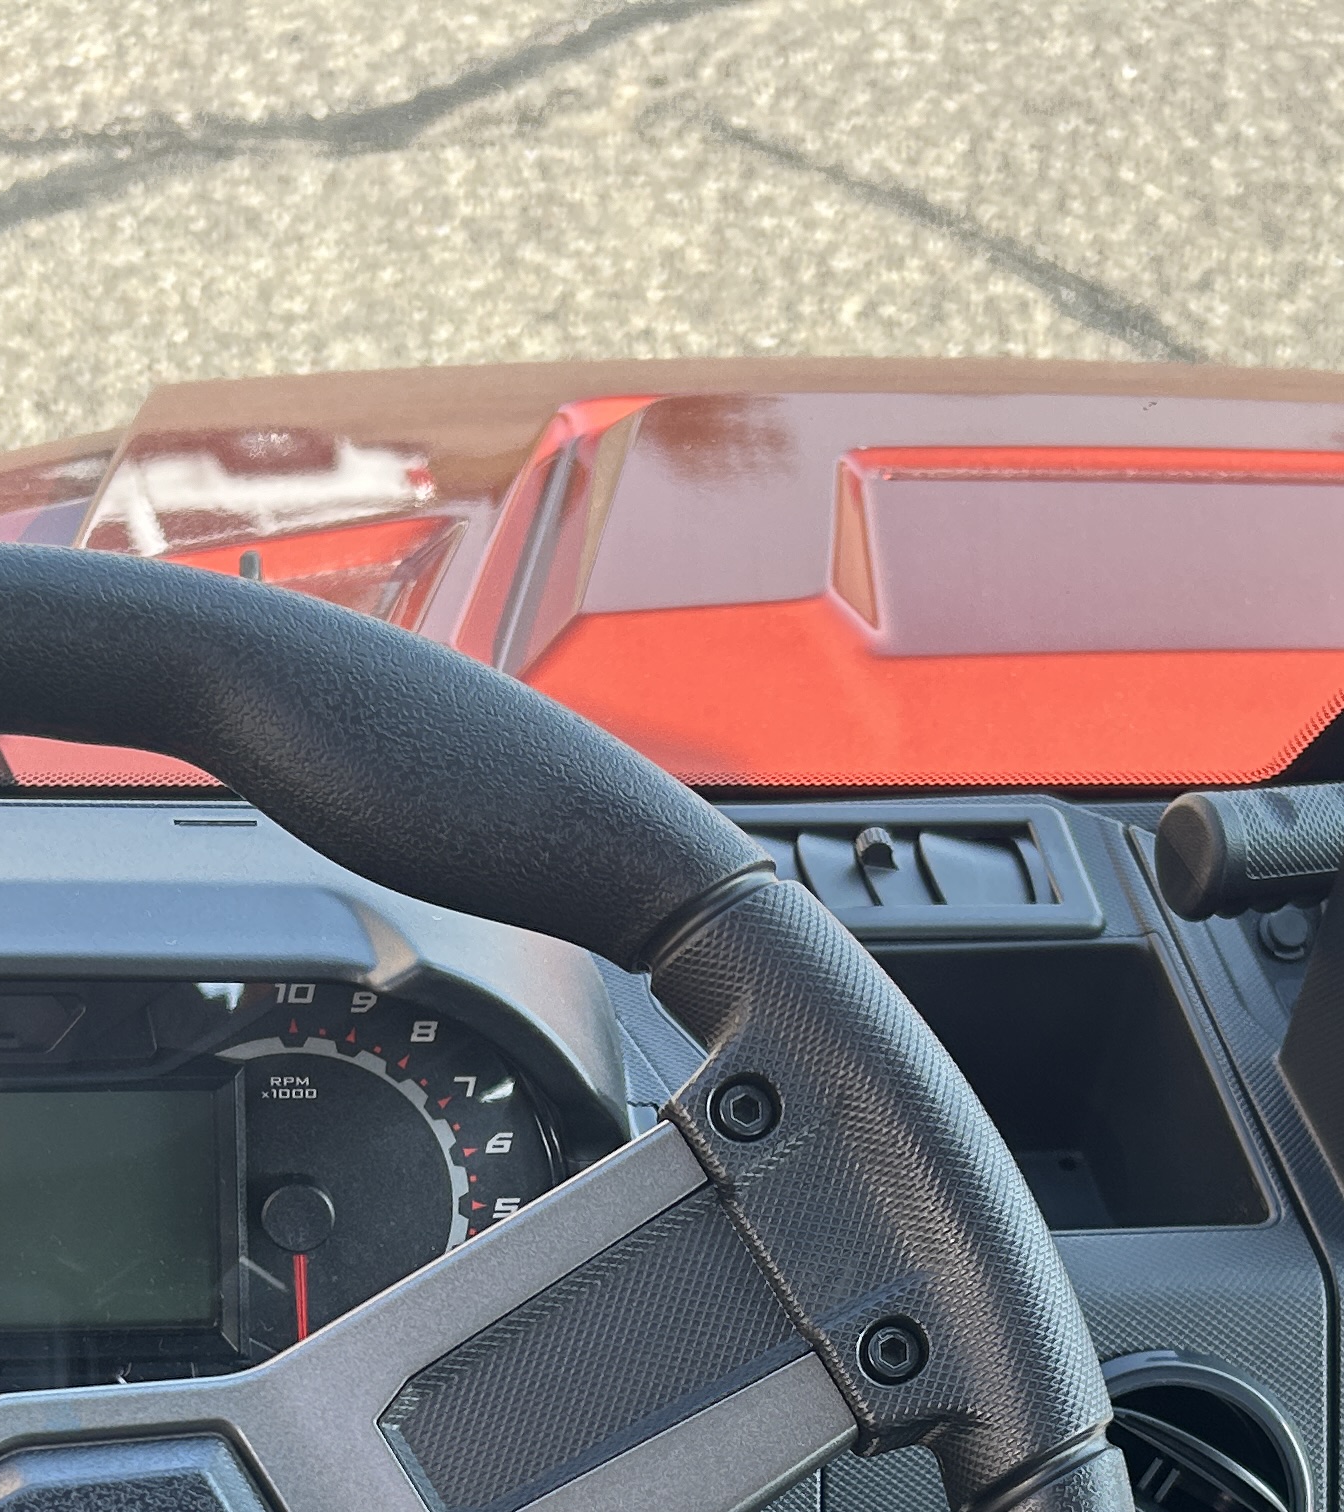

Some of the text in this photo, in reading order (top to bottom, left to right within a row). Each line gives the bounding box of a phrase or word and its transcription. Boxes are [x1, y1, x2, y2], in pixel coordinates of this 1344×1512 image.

[274, 983, 316, 1004] 10
[351, 991, 379, 1013] 9
[409, 1020, 439, 1043] 8
[269, 1076, 311, 1087] RPM
[453, 1076, 478, 1099] 7
[485, 1132, 514, 1155] 6
[492, 1197, 521, 1219] 5
